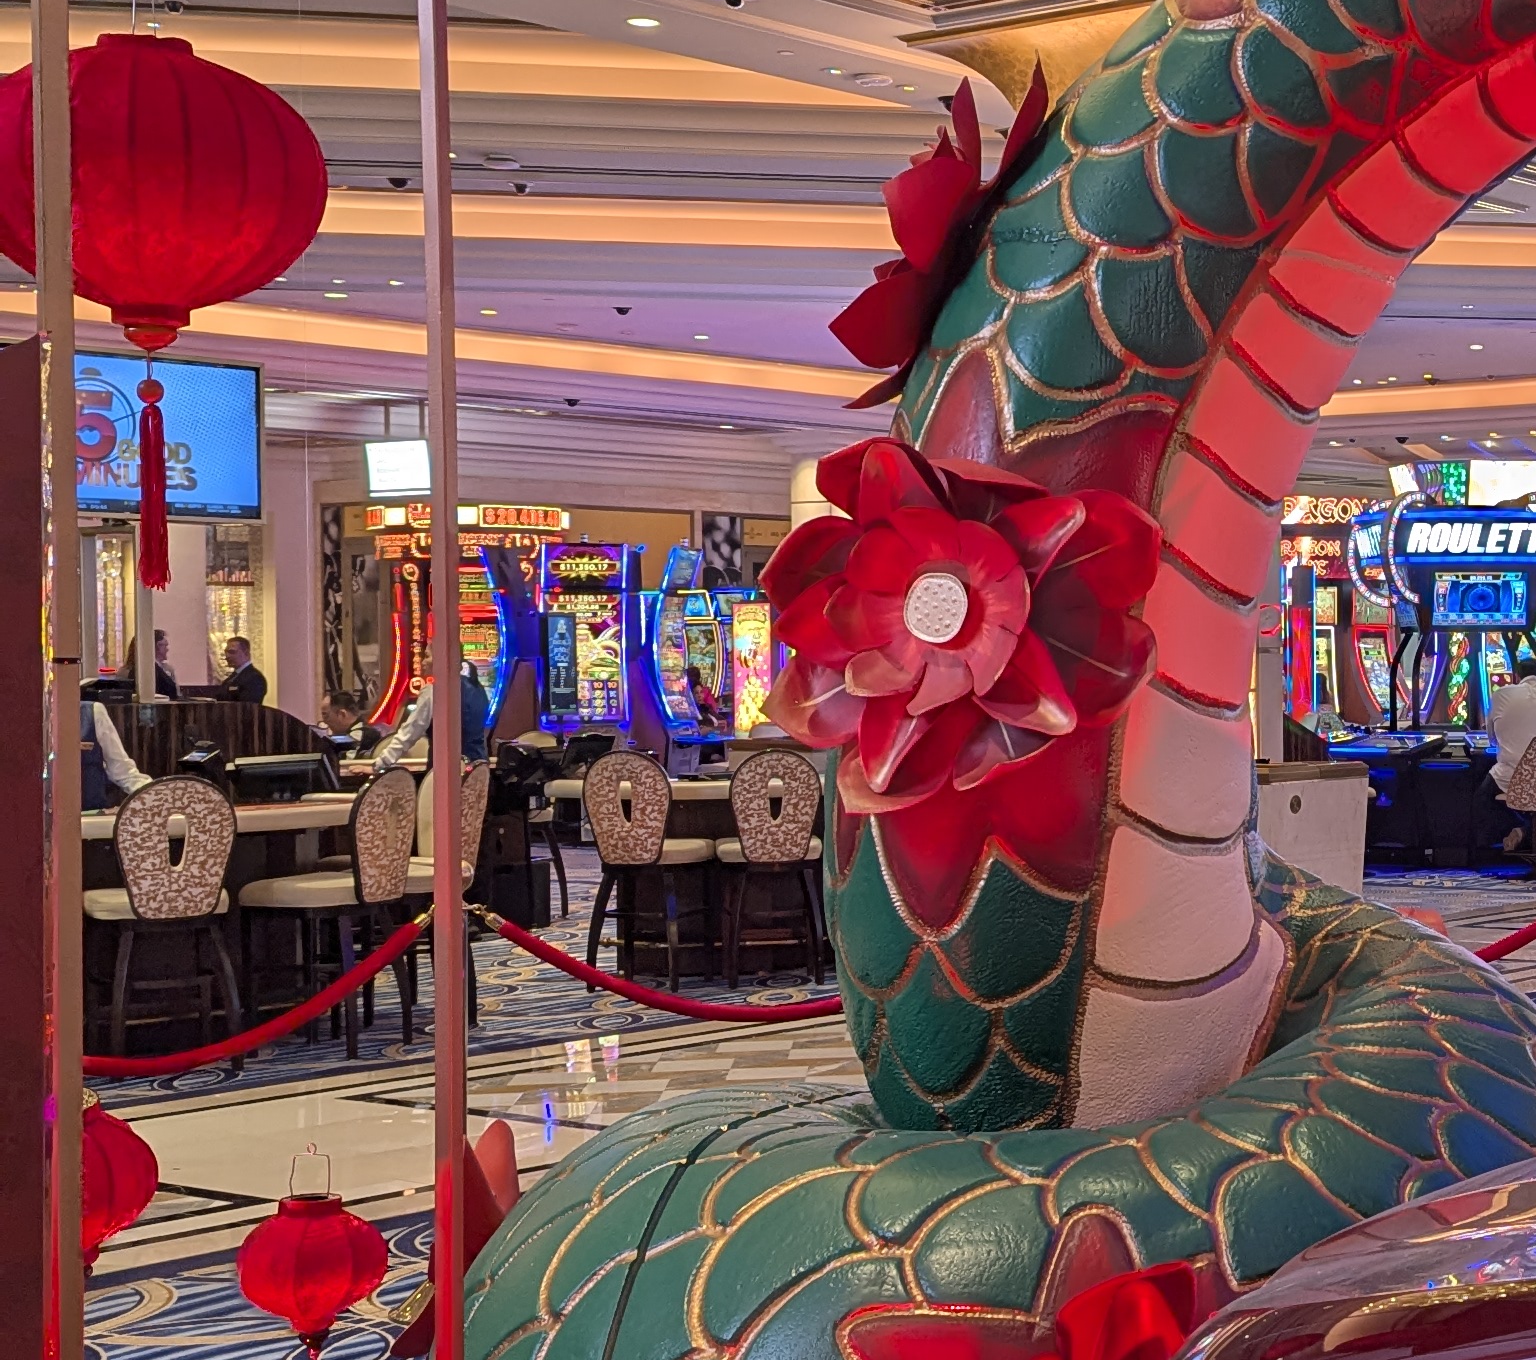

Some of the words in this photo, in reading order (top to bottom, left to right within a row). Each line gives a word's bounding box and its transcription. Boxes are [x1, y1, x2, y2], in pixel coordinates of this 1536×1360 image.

[118, 439, 192, 464] GOD
[77, 462, 198, 490] MINUES
[1284, 496, 1364, 524] RAGON
[1281, 540, 1341, 557] RAGON
